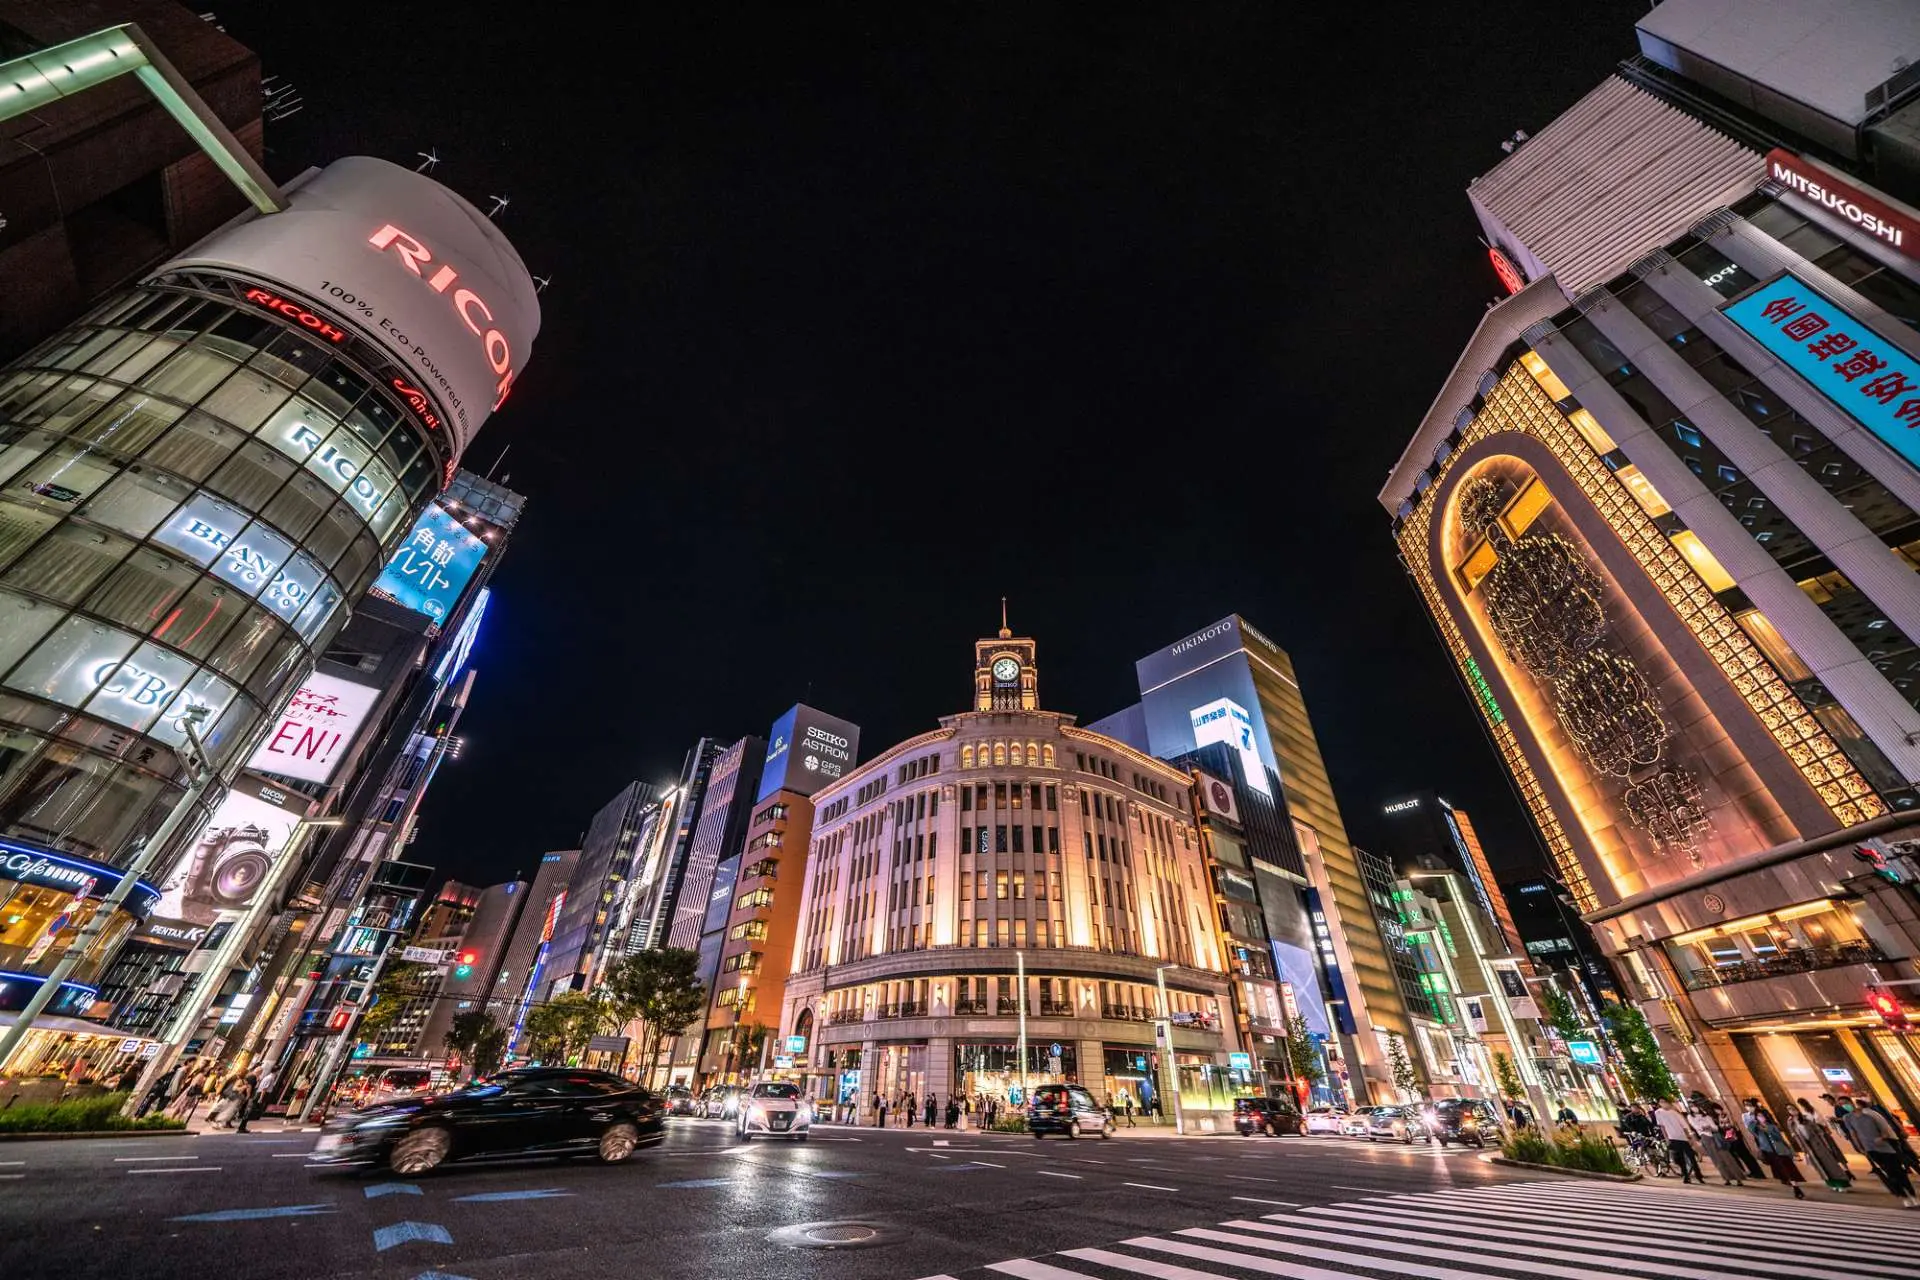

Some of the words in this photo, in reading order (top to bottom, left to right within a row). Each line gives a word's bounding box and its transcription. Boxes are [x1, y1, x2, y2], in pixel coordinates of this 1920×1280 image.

[1773, 162, 1903, 246] MITSUKOSHI
[245, 288, 346, 343] RICOH
[320, 280, 374, 319] 100%
[379, 317, 462, 410] Eco-Powered
[411, 527, 456, 569] 角散
[232, 561, 290, 607] TOYO
[1171, 621, 1232, 656] MIKIMOTO
[1240, 620, 1278, 654] MIKIMOTO
[801, 737, 849, 761] ASTRON
[806, 726, 848, 749] SEIKO
[820, 767, 841, 778] SOLAR
[821, 760, 841, 773] GPS
[1384, 799, 1419, 814] HUBLOT
[6, 853, 49, 879] Café
[150, 924, 184, 939] PENTAX
